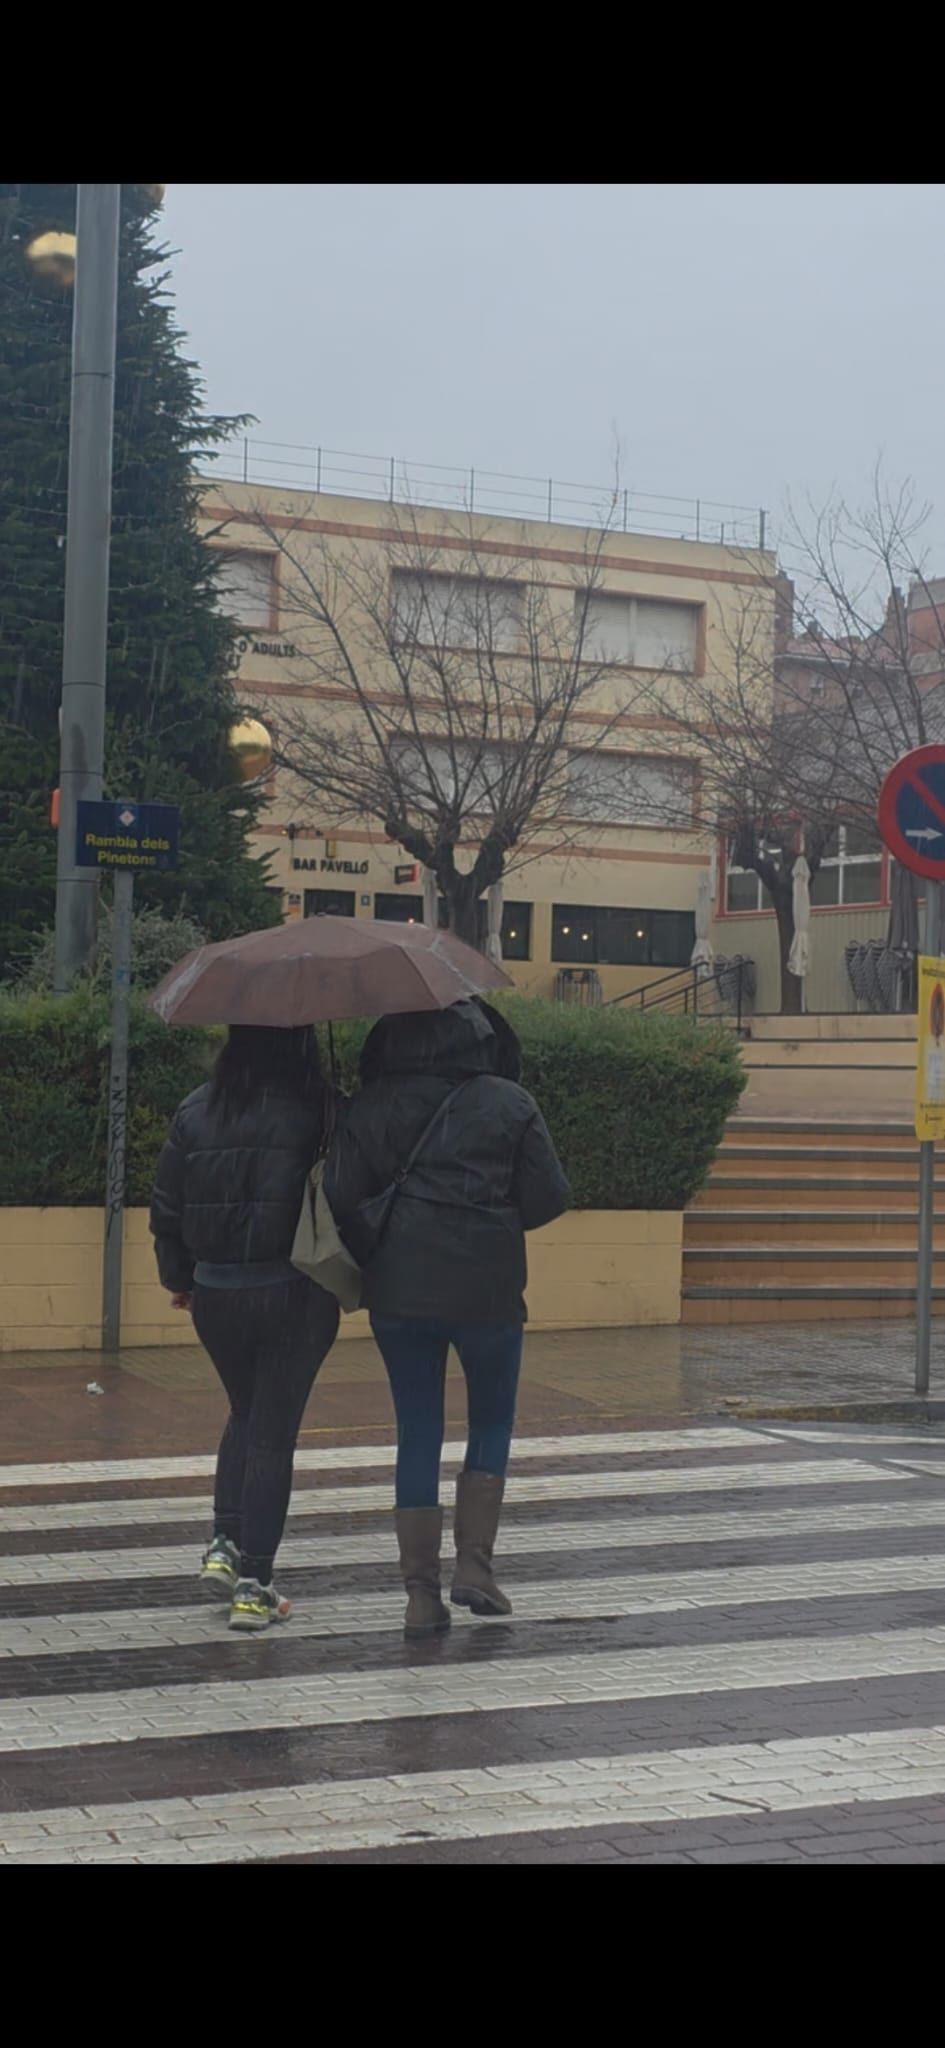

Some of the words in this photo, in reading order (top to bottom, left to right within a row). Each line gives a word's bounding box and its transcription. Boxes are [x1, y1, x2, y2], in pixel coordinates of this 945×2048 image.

[85, 833, 138, 849] Rambla
[141, 838, 170, 850] dels
[97, 851, 157, 865] Pinetons
[293, 858, 316, 871] BAR
